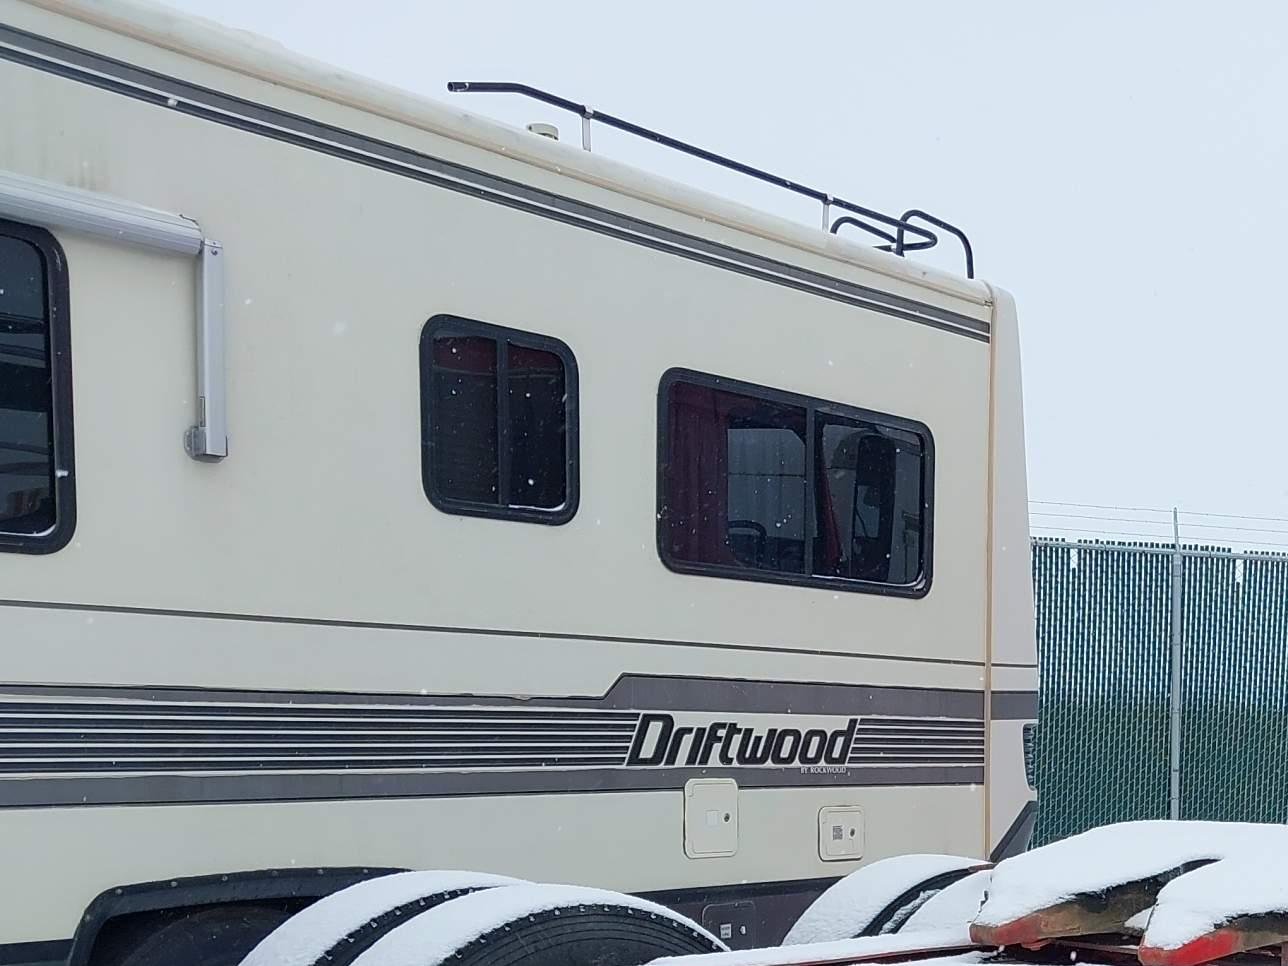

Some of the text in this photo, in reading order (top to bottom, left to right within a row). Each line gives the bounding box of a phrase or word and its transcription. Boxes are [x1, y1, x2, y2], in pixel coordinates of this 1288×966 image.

[626, 713, 859, 767] Driftwood
[800, 766, 847, 774] BY ROCKWOOD
